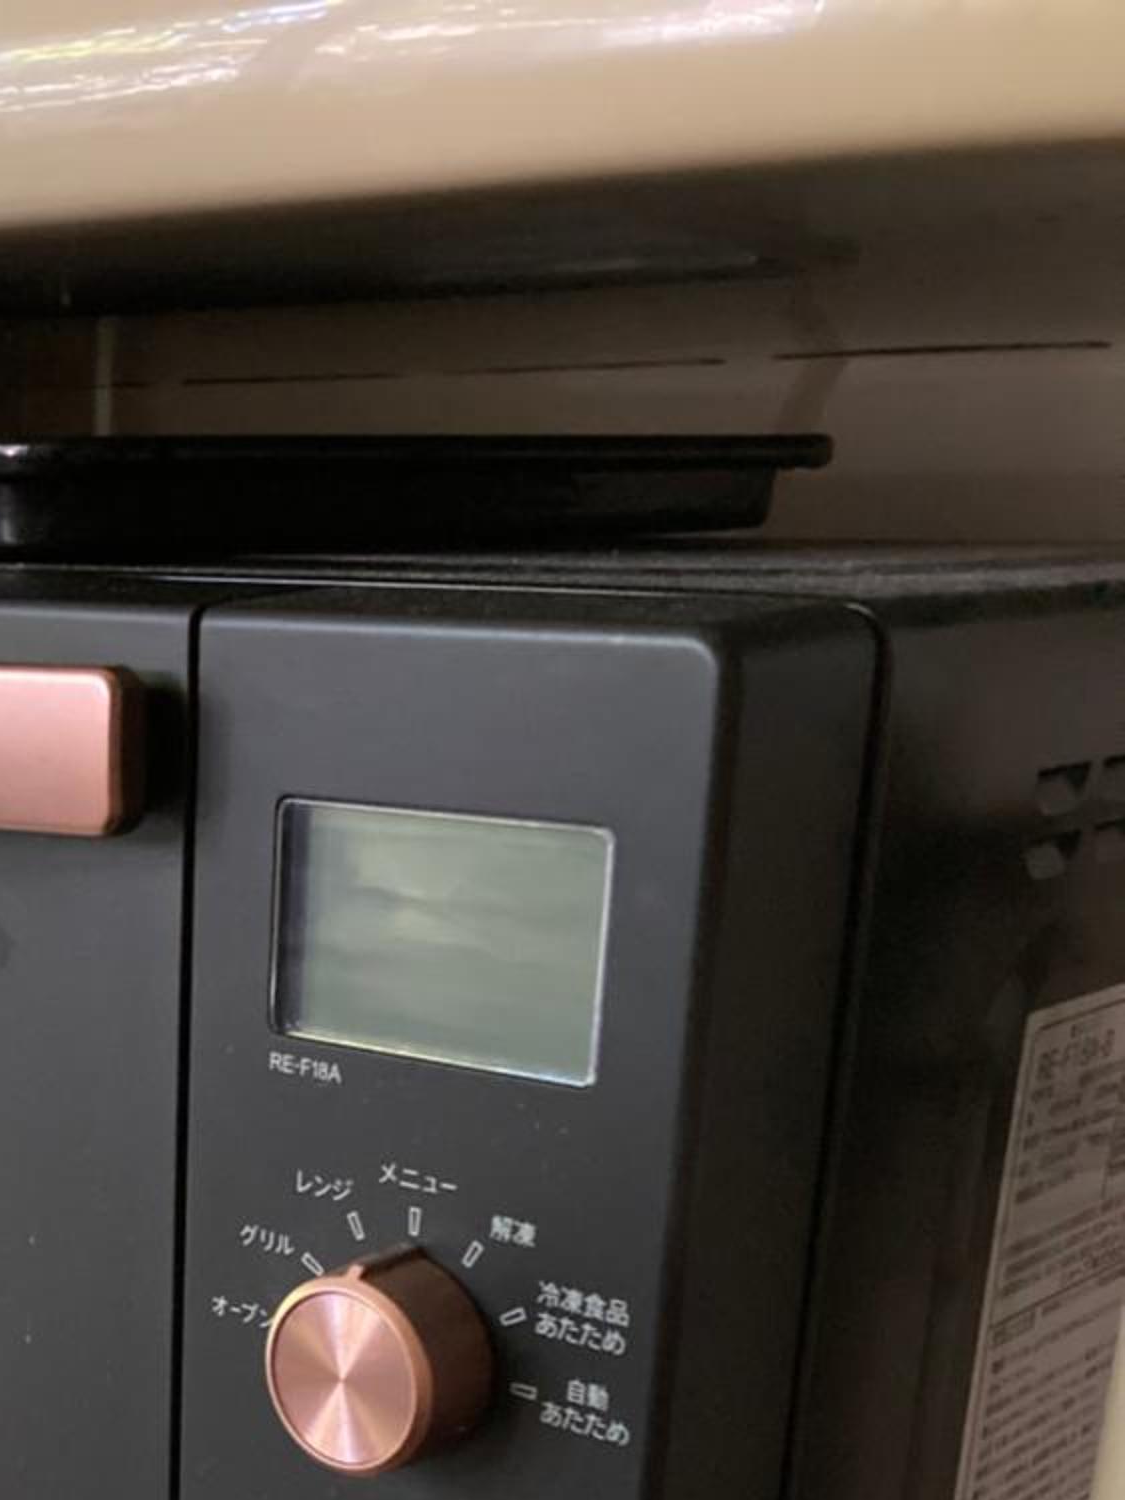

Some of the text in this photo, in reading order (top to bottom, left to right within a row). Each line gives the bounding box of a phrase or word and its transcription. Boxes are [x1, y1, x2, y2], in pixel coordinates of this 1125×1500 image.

[269, 1052, 342, 1083] RE-F18A
[296, 1170, 354, 1200] レンジ
[379, 1163, 457, 1194] メニュー
[239, 1225, 294, 1256] グリル
[489, 1215, 537, 1248] 解凍
[537, 1281, 630, 1327] 冷凍食品
[534, 1313, 627, 1356] あたため
[566, 1379, 610, 1411] 自動
[540, 1402, 630, 1446] あたため
